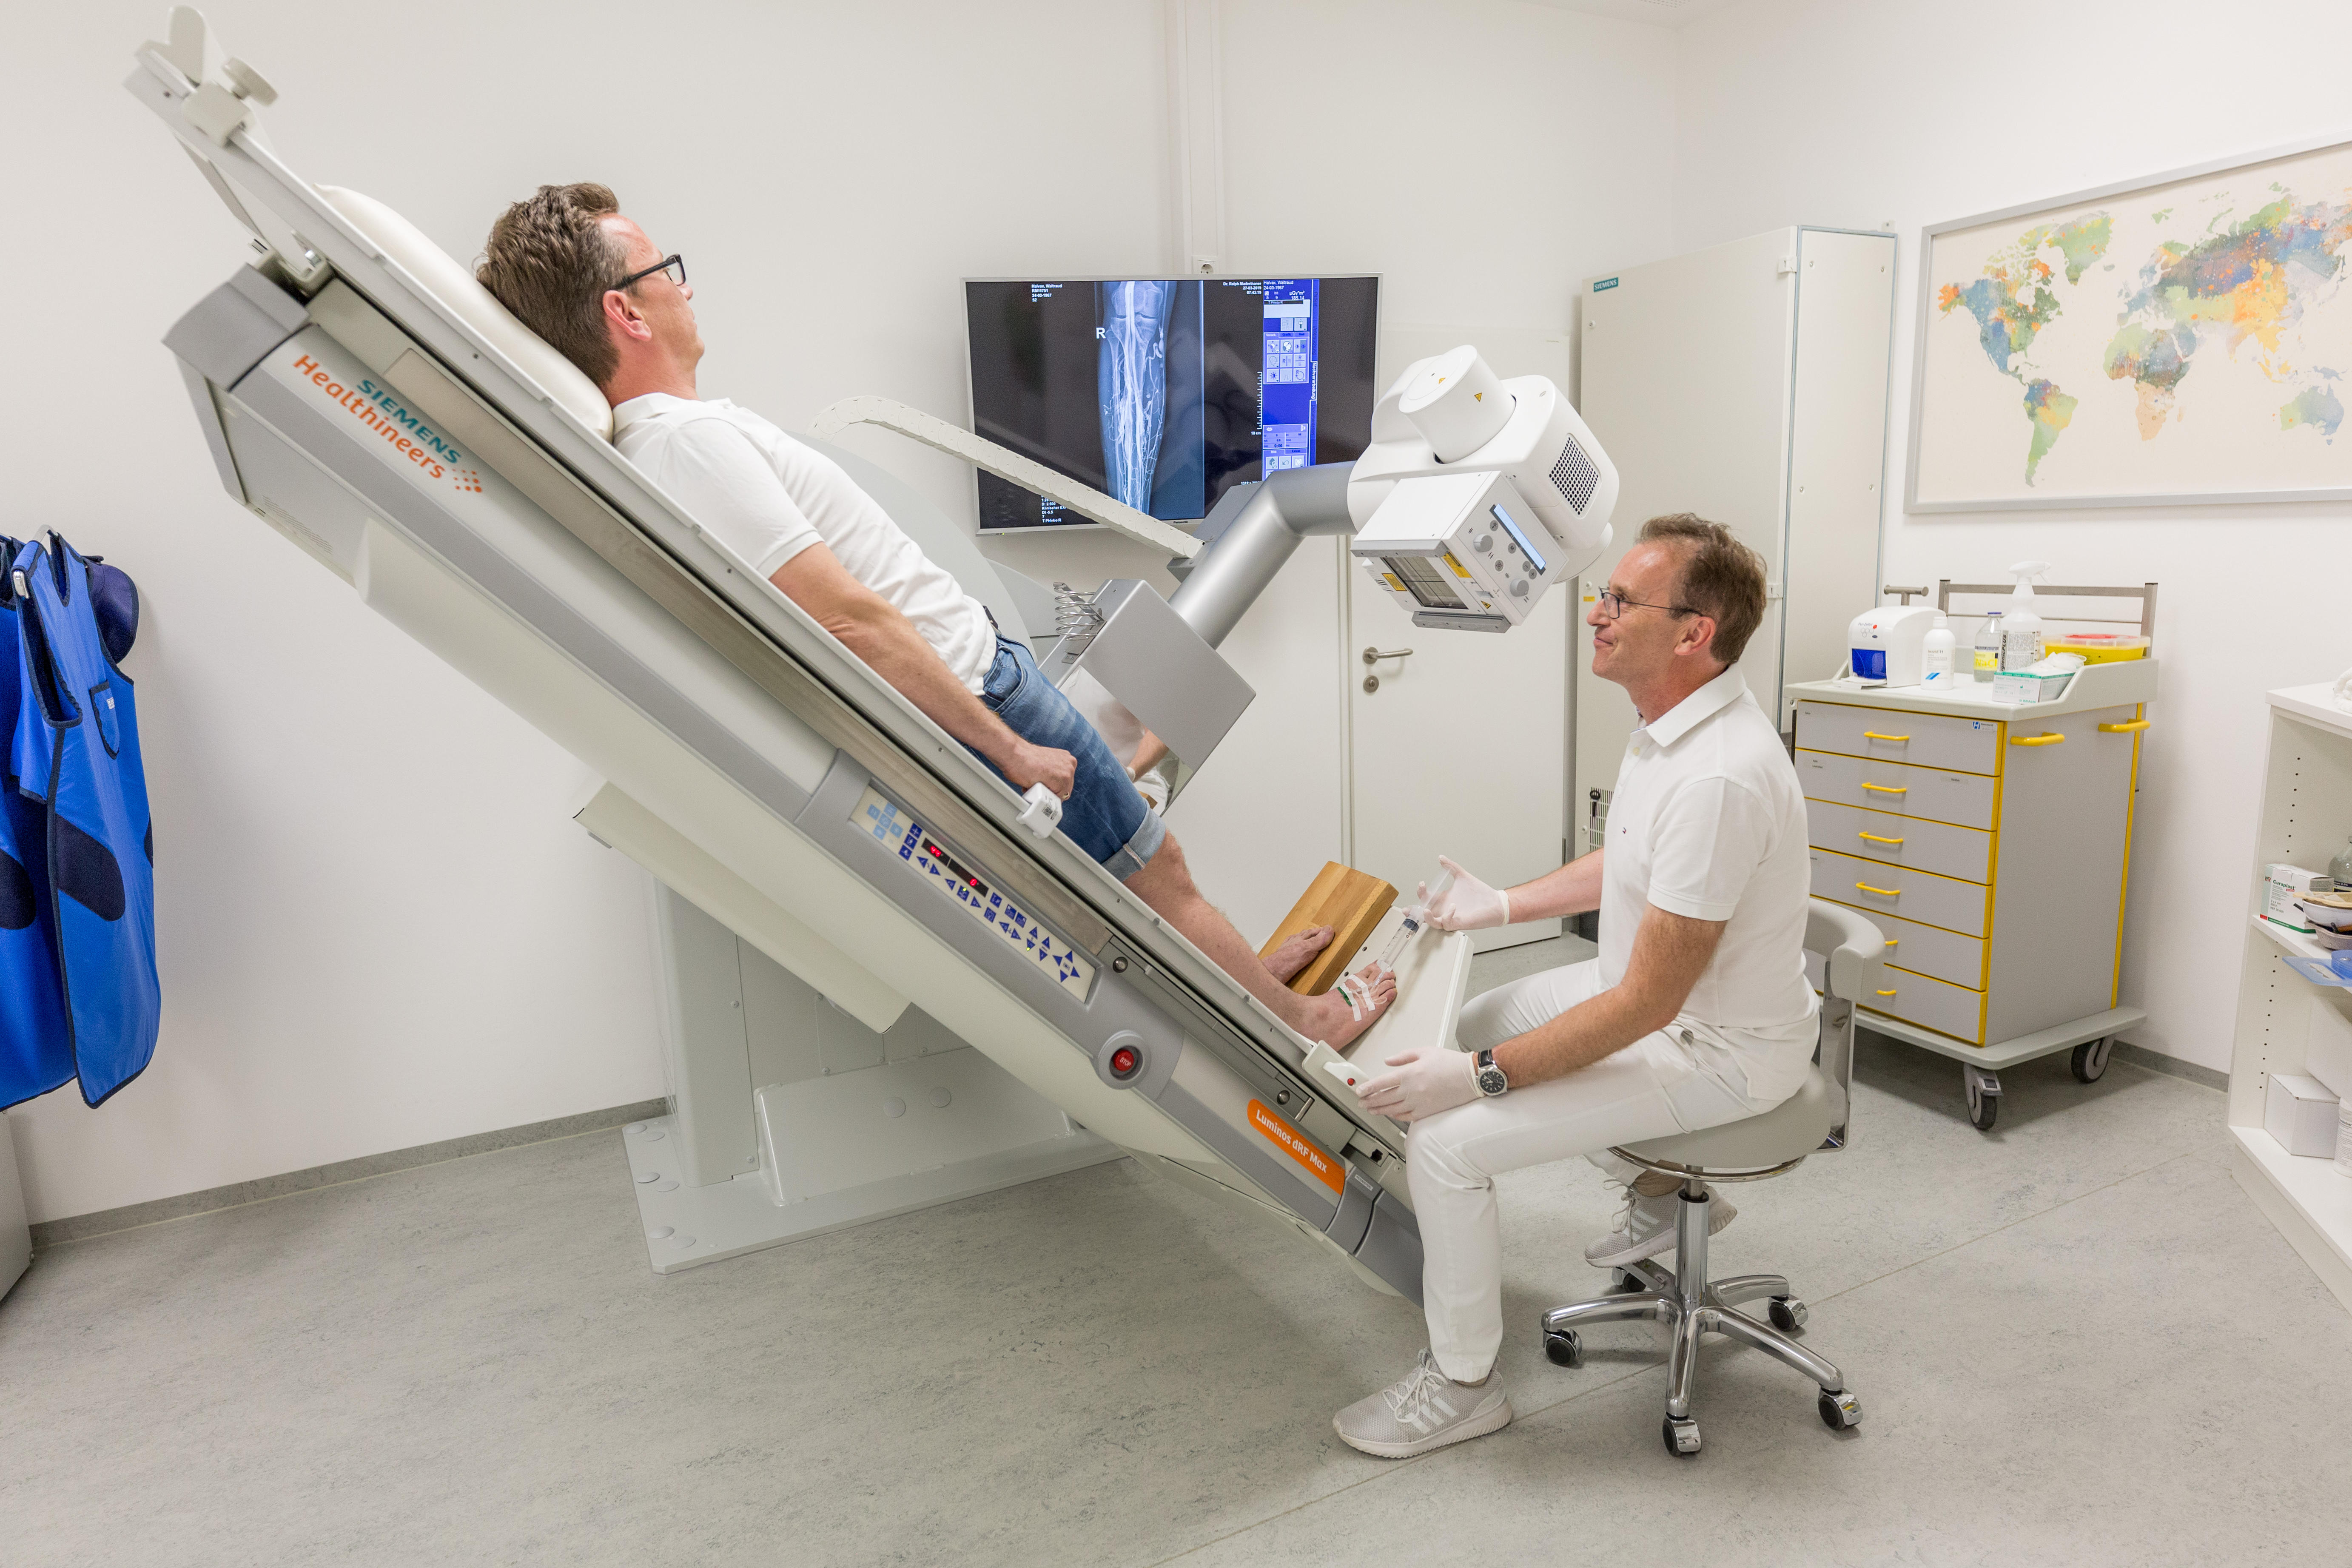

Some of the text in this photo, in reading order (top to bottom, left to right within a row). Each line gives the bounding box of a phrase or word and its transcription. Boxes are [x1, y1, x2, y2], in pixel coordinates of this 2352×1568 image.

[1595, 279, 1617, 290] SIEMENS
[1096, 327, 1106, 339] R
[293, 354, 445, 478] Healthineers
[357, 379, 461, 464] SIEMENS
[1976, 658, 1997, 667] NaCl
[2273, 879, 2295, 889] Curaplast
[1119, 1057, 1131, 1067] STOP
[1256, 1109, 1327, 1173] Luminos dRF Max
